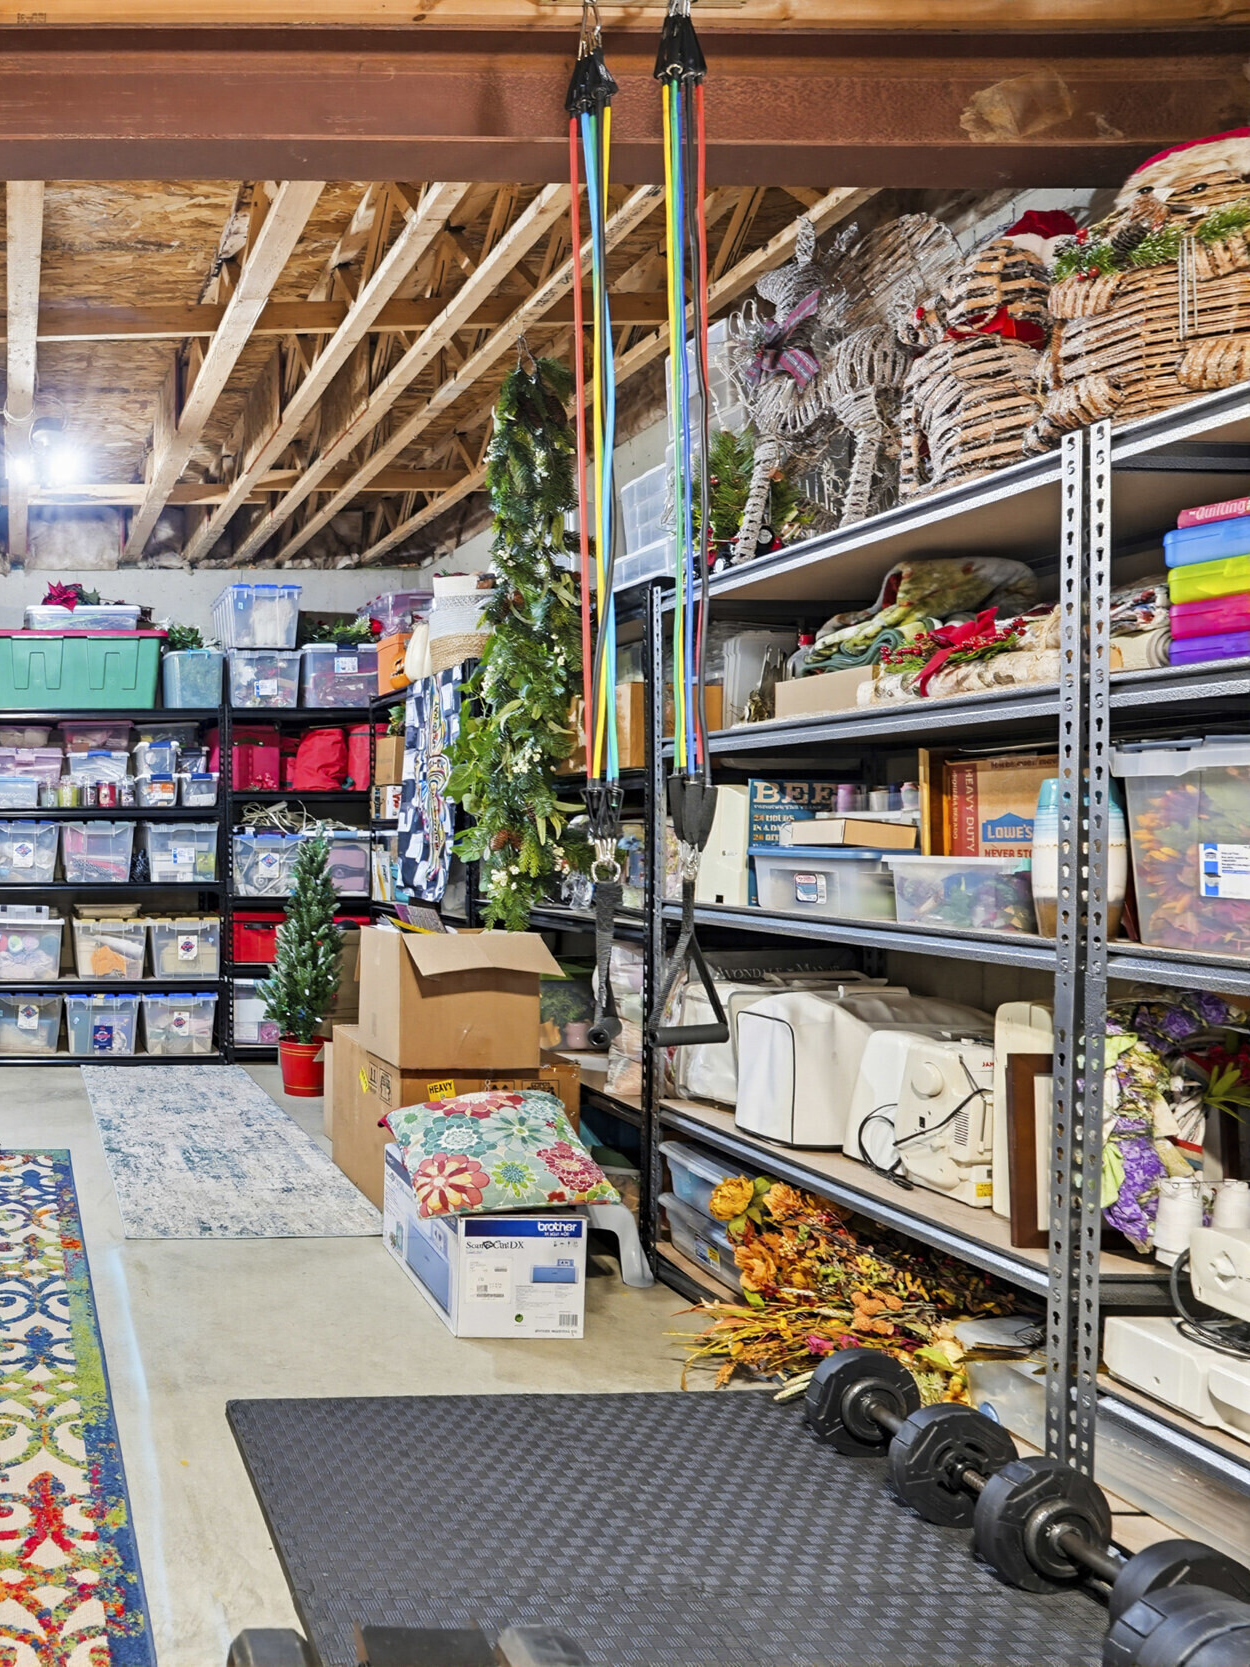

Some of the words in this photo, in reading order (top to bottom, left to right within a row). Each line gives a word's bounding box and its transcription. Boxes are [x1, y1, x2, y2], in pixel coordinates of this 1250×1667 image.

[753, 782, 838, 804] BEE
[965, 769, 975, 813] HEAVY
[966, 816, 975, 852] DUTY
[987, 824, 1033, 839] LOWE'S
[984, 849, 1016, 858] NEVER
[1017, 849, 1033, 858] ST
[428, 1082, 454, 1094] HEAVY
[537, 1221, 577, 1232] brother
